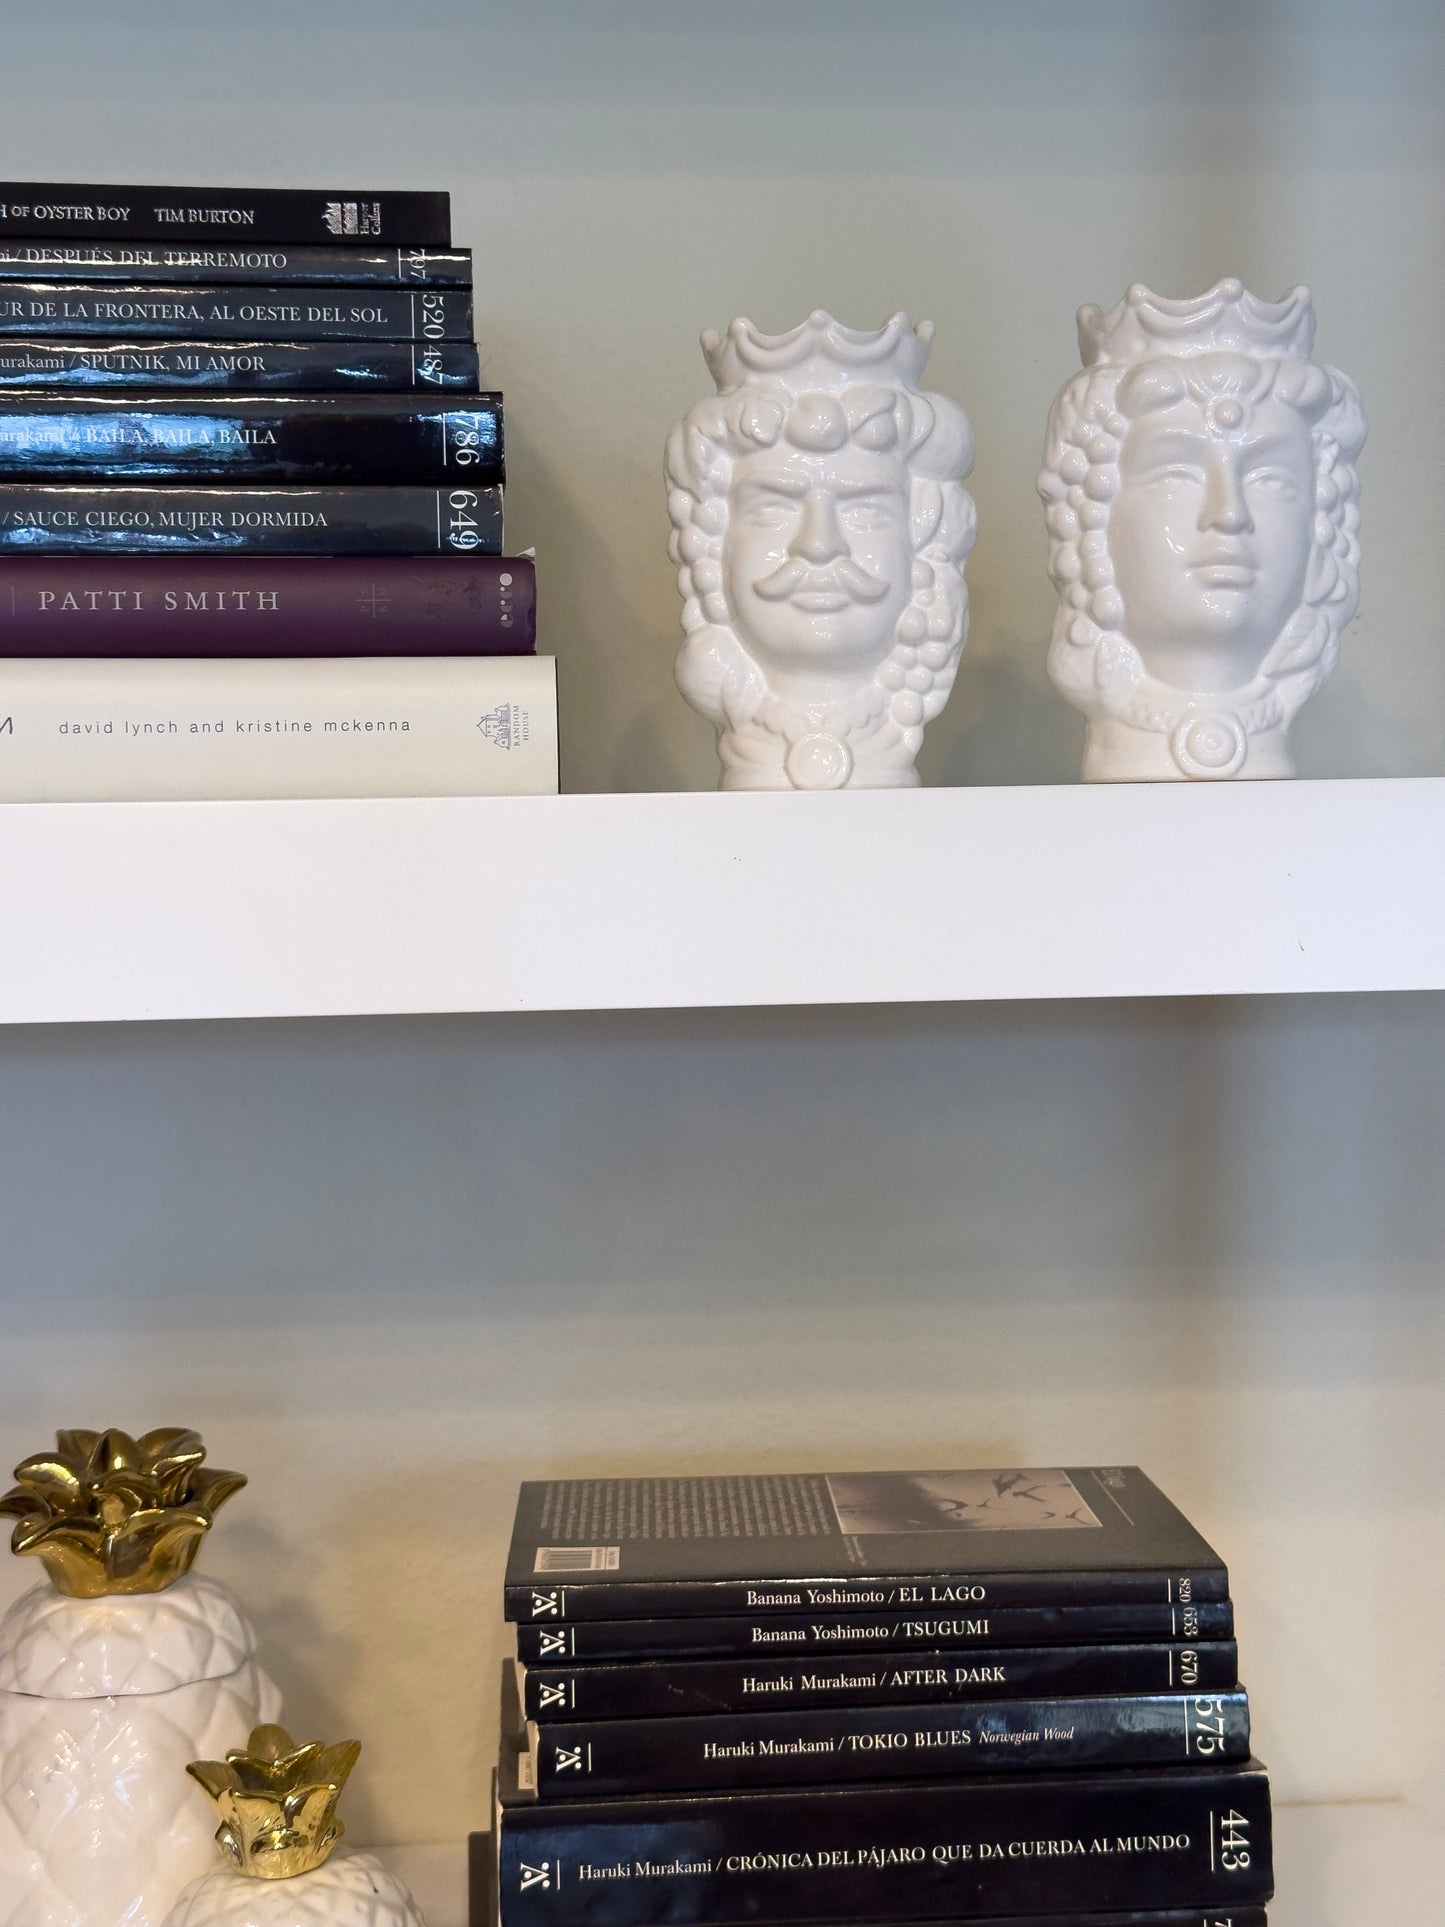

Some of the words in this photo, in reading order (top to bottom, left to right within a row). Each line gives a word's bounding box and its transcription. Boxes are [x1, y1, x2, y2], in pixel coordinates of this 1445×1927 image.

[12, 206, 30, 217] OF
[33, 205, 94, 220] OYSTER
[98, 207, 130, 221] BOY
[154, 208, 185, 223] TIM
[189, 209, 254, 224] BURTON
[360, 203, 371, 235] Harper
[26, 247, 113, 264] DESPUÉS
[119, 250, 158, 265] DEL
[164, 251, 287, 269] TERREMOTO
[410, 249, 427, 280] 797
[30, 302, 57, 317] DE
[63, 302, 88, 317] LA
[95, 303, 205, 322] FRONTERA,
[209, 306, 235, 321] AL
[239, 306, 301, 321] OESTE
[308, 307, 346, 323] DEL
[350, 308, 388, 324] SOL
[422, 294, 445, 339] 520
[80, 354, 170, 371] SPUTNIK,
[176, 355, 201, 370] MI
[205, 356, 267, 372] AMOR
[423, 345, 444, 385] 487
[86, 428, 148, 446] BAILA,
[152, 430, 216, 447] BAILA,
[219, 429, 278, 445] BAILA
[455, 414, 480, 466] 786
[14, 511, 79, 526] SAUCE
[85, 511, 154, 529] CIEGO,
[159, 511, 224, 531] MUJER
[231, 511, 329, 528] DORMIDA
[449, 490, 480, 550] 649
[38, 591, 145, 611] PATTI
[165, 591, 280, 611] SMITH
[59, 721, 114, 734] david
[125, 720, 178, 737] lynch
[190, 720, 225, 733] and
[235, 719, 313, 733] kristine
[323, 719, 411, 733] mckenna
[513, 705, 521, 747] RANDOM
[747, 1590, 801, 1606] Banana
[806, 1588, 884, 1604] Yoshimoto
[899, 1587, 923, 1602] EL
[930, 1585, 986, 1601] LAGO
[1179, 1577, 1192, 1603] 820
[752, 1627, 806, 1643] Banana
[811, 1624, 889, 1641] Yoshimoto
[902, 1619, 990, 1637] TSUGUMI
[1183, 1606, 1198, 1636] 653
[742, 1677, 794, 1693] Haruki
[801, 1673, 876, 1690] Murakami
[890, 1668, 948, 1686] AFTER
[955, 1666, 1006, 1684] DARK
[1180, 1650, 1198, 1685] 670
[1195, 1697, 1226, 1754] 575
[704, 1742, 754, 1759] Haruki
[759, 1738, 834, 1755] Murakami
[847, 1733, 908, 1750] TOKIO
[915, 1730, 972, 1746] BLUES
[979, 1728, 1040, 1745] Norwegian
[1043, 1726, 1075, 1741] Wood
[1220, 1808, 1250, 1872] 443
[579, 1864, 630, 1880] Haruki
[635, 1859, 712, 1877] Murakami
[726, 1851, 813, 1872] CRÓNICA
[817, 1849, 856, 1867] DEL
[857, 1845, 926, 1869] PÁJARO
[932, 1844, 973, 1866] QUE
[979, 1842, 1003, 1859] DA
[1010, 1838, 1086, 1858] CUERDA
[1089, 1837, 1114, 1855] AL
[1116, 1834, 1191, 1852] MUNDO
